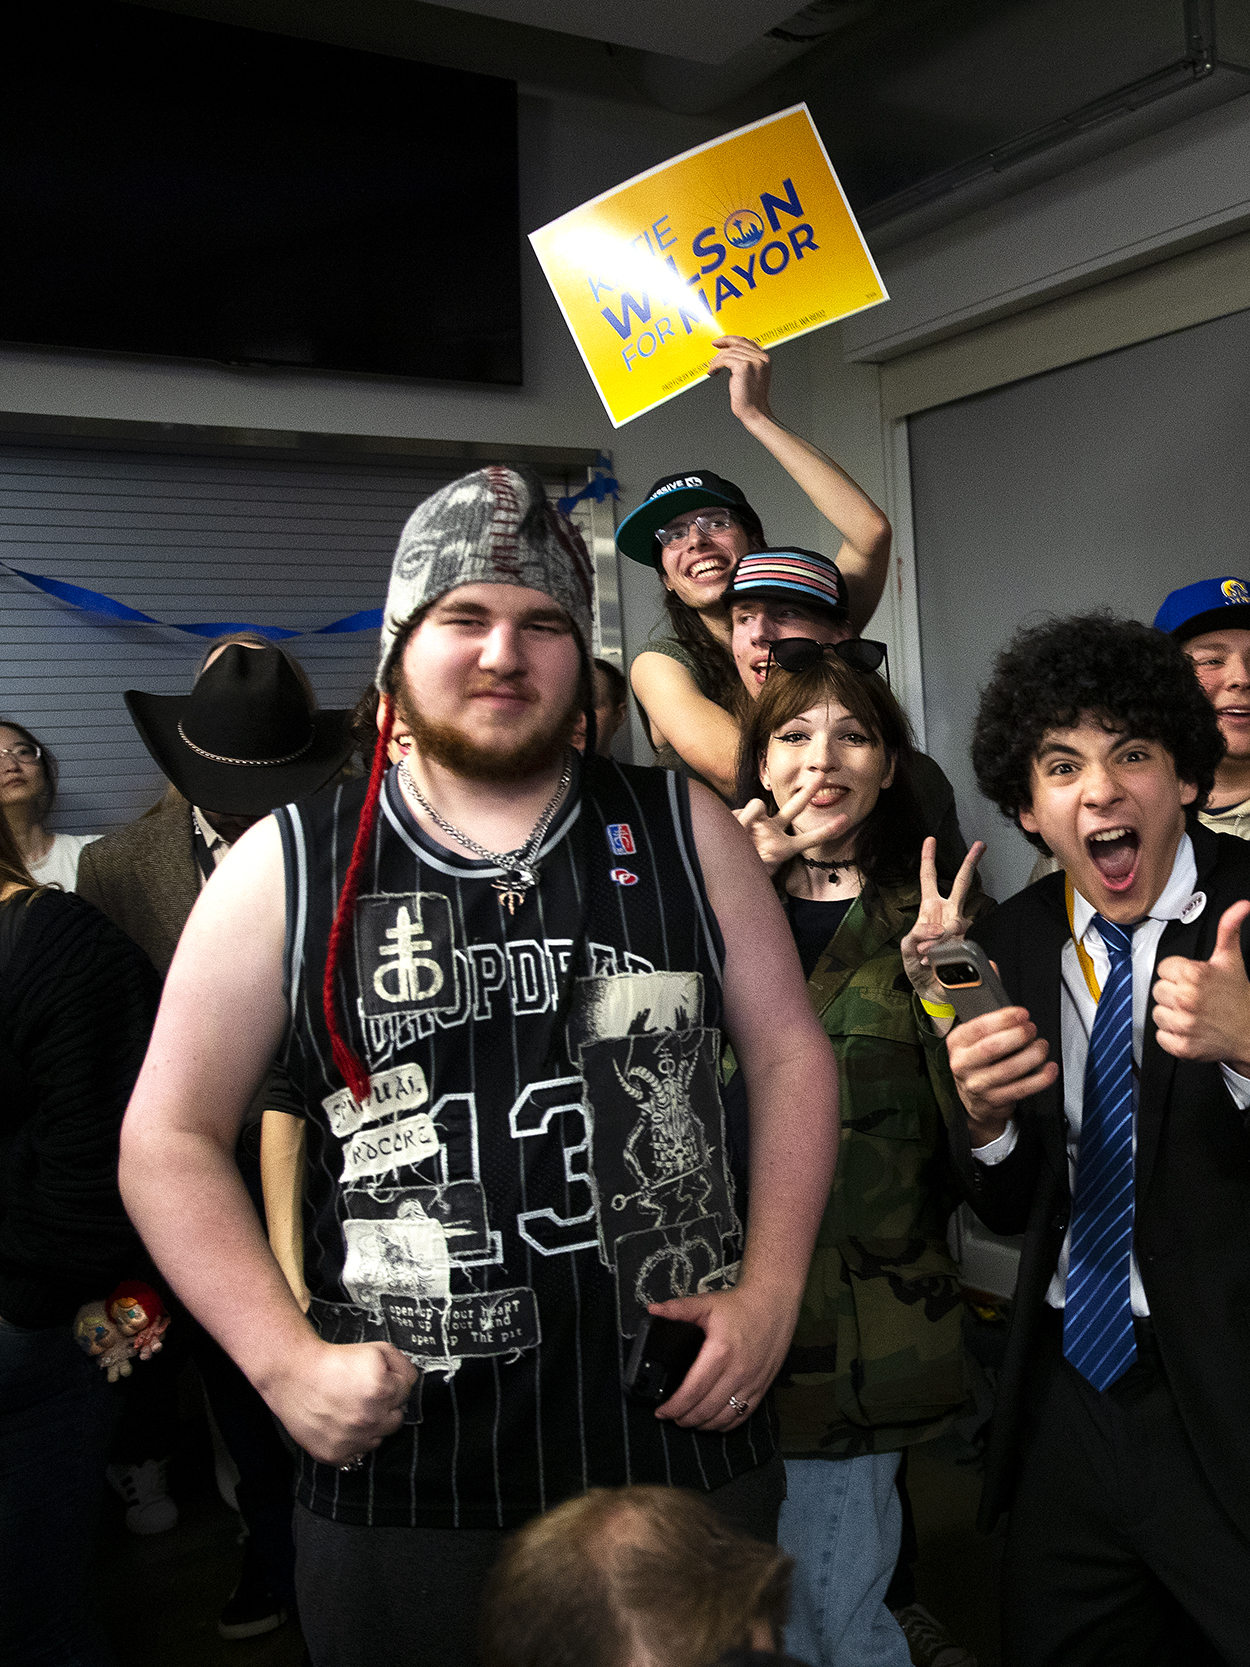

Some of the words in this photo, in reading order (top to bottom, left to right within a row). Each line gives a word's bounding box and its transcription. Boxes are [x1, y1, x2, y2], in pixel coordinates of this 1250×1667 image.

[588, 214, 677, 303] KIE
[621, 317, 675, 372] FOR
[677, 223, 820, 335] MAYOR
[389, 1305, 414, 1317] open
[418, 1320, 432, 1332] up
[411, 1334, 436, 1346] open
